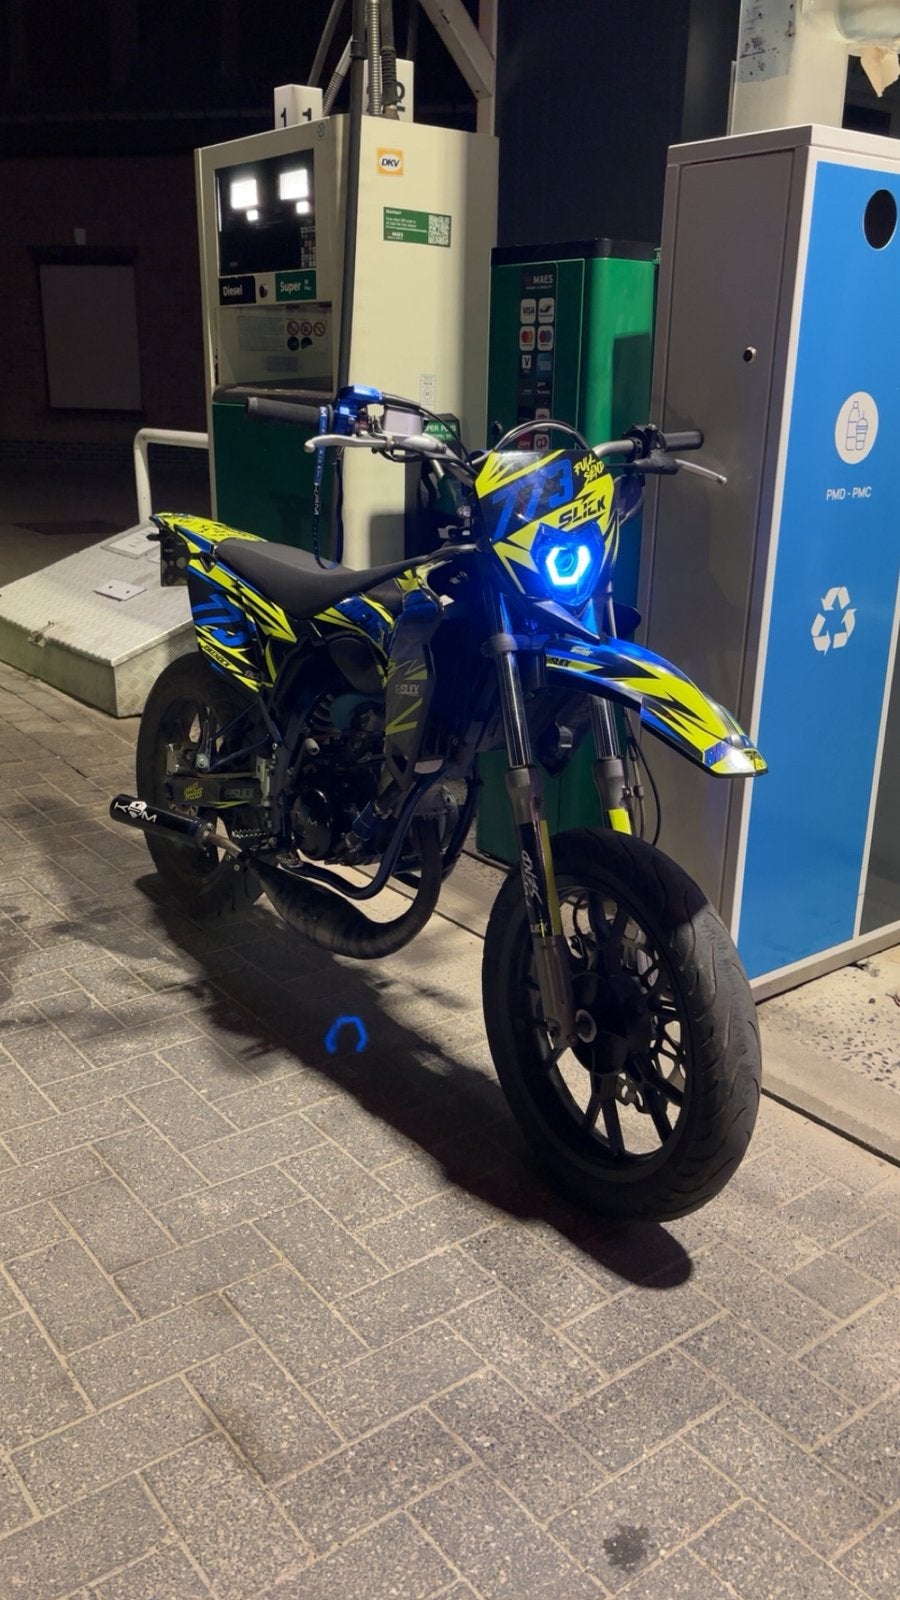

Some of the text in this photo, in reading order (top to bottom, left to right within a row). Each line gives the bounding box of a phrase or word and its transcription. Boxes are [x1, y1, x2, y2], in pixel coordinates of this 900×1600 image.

[381, 158, 400, 168] DKV
[532, 273, 554, 285] MAES
[222, 283, 244, 298] Diesel
[279, 280, 302, 295] Super
[572, 453, 597, 477] FULL
[583, 460, 606, 484] SEND
[491, 458, 575, 543] 773
[826, 488, 846, 501] PMD
[852, 486, 872, 499] PMC
[558, 493, 607, 526] SLICK
